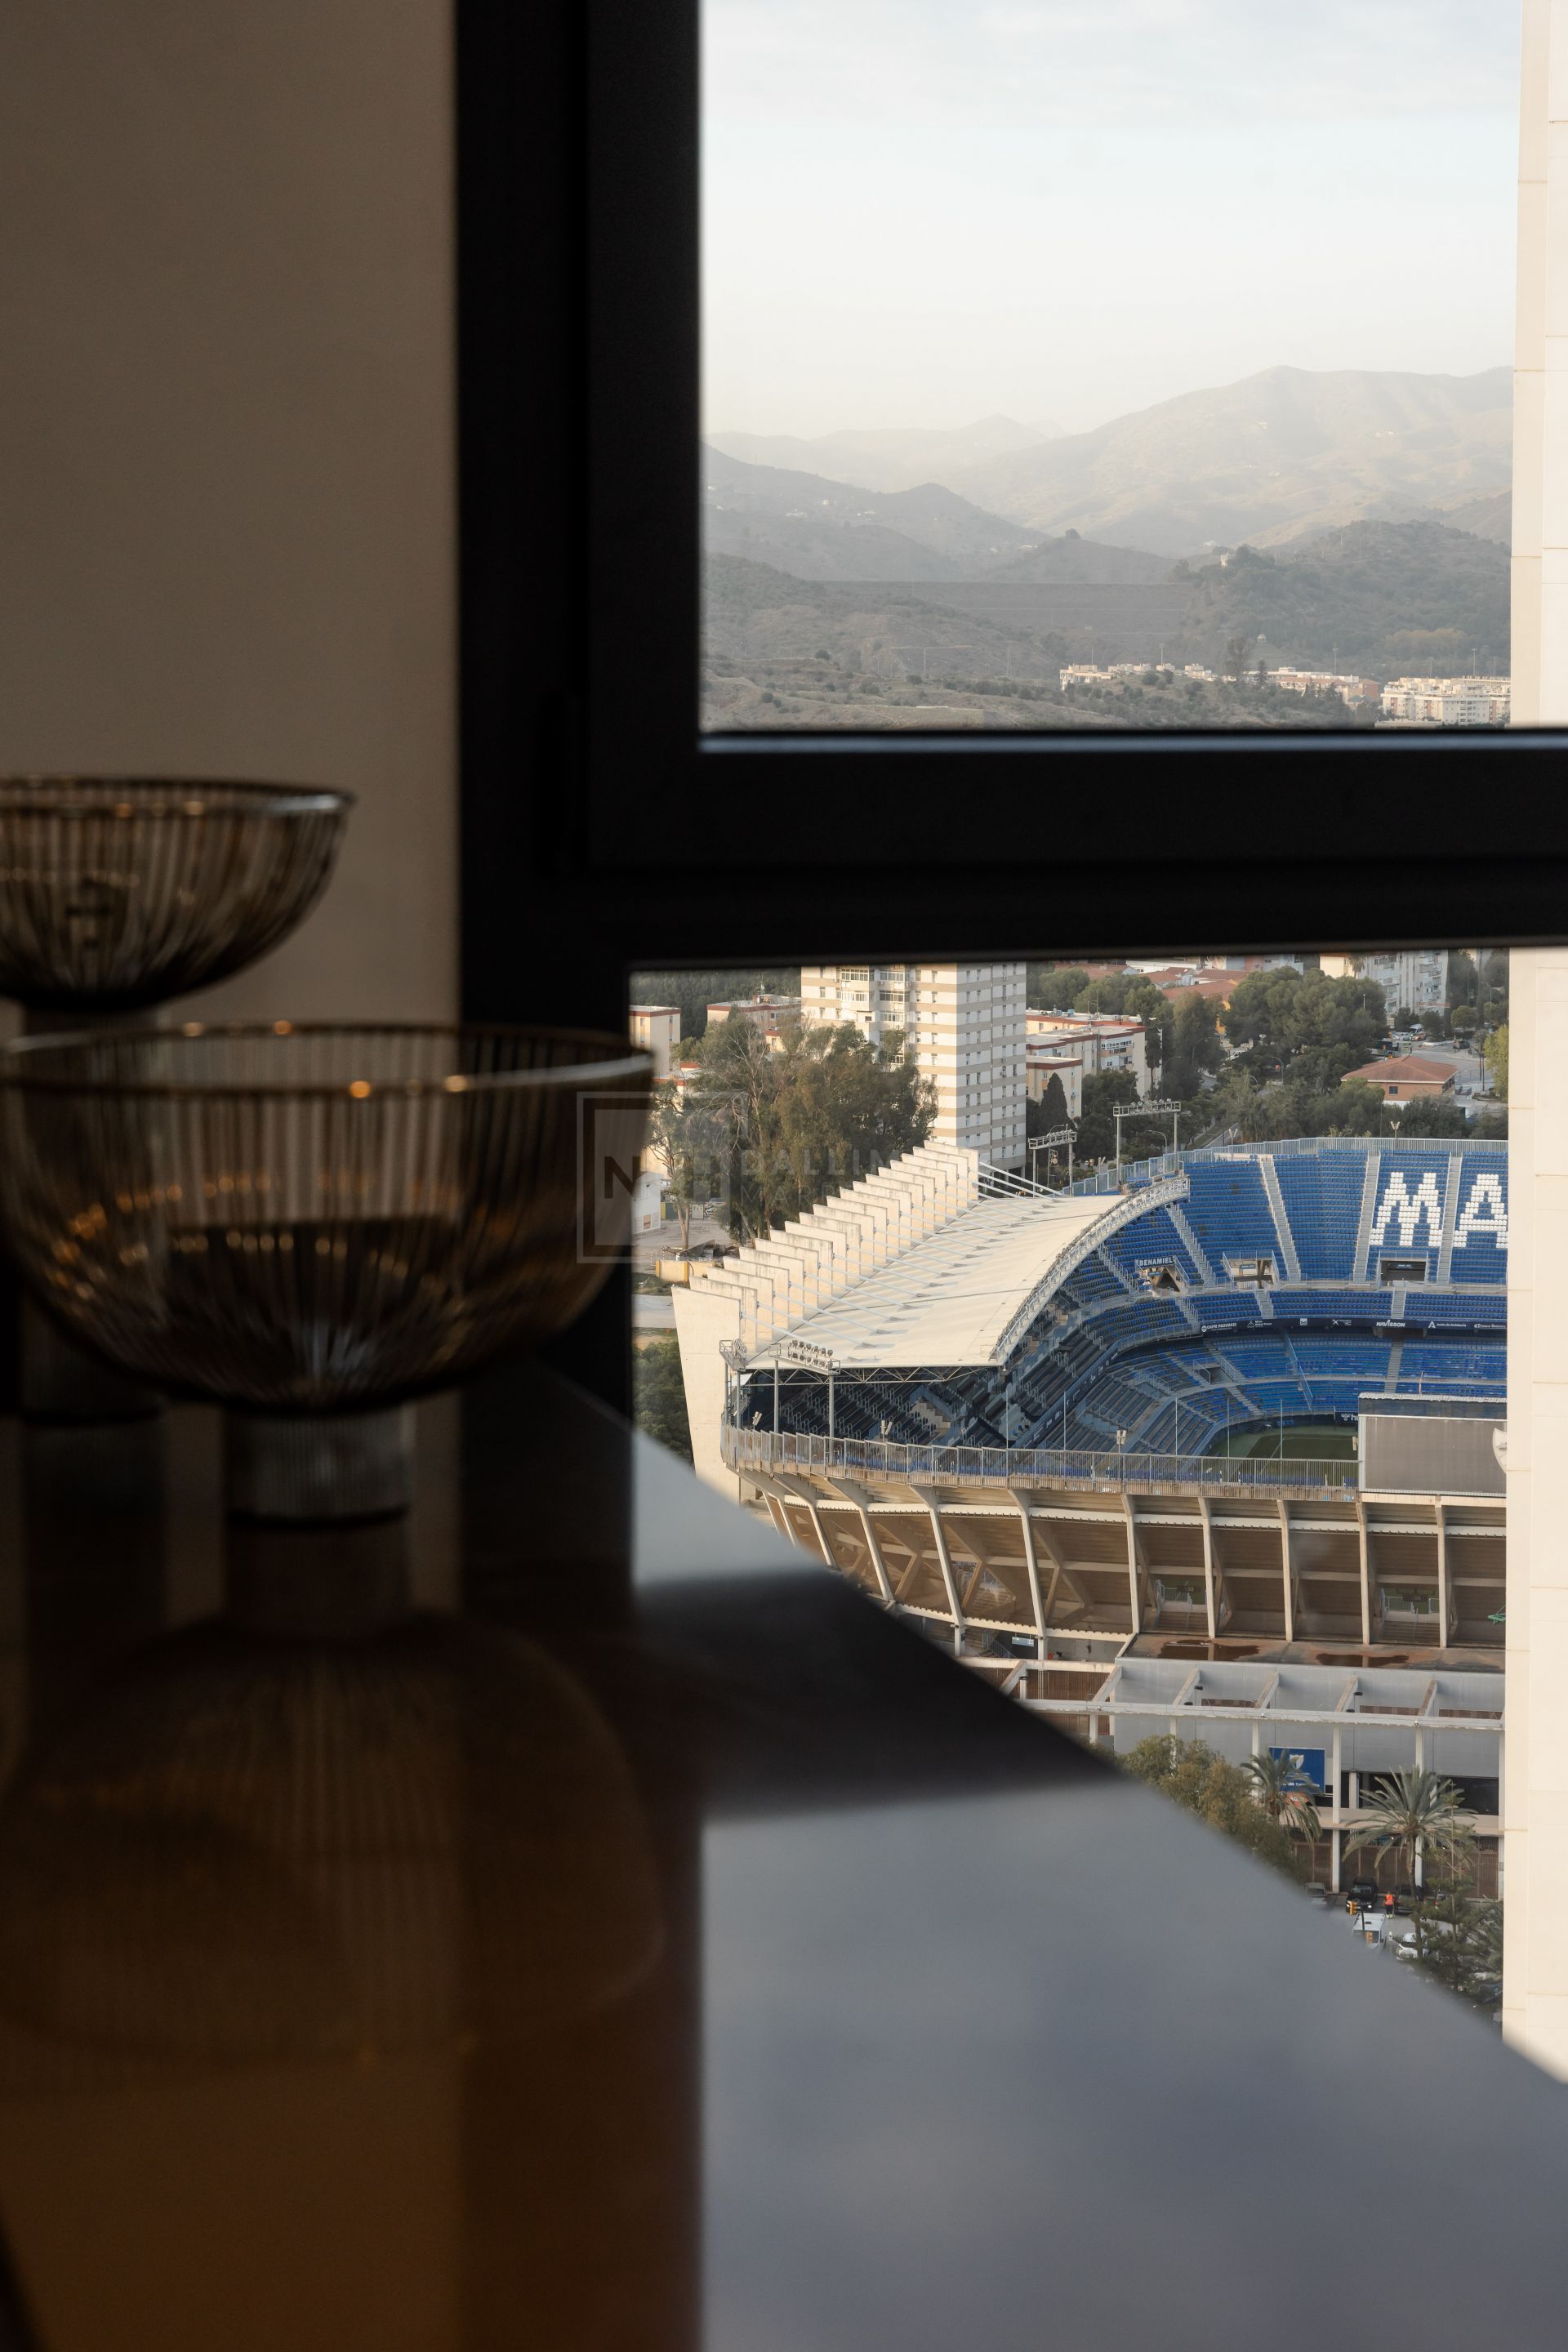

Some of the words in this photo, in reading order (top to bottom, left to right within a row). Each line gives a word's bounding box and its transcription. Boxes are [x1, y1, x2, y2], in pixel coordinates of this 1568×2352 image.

[1370, 1172, 1508, 1249] MA
[1139, 1257, 1173, 1267] BENAMIEL
[1376, 1319, 1405, 1328] NAVISSON
